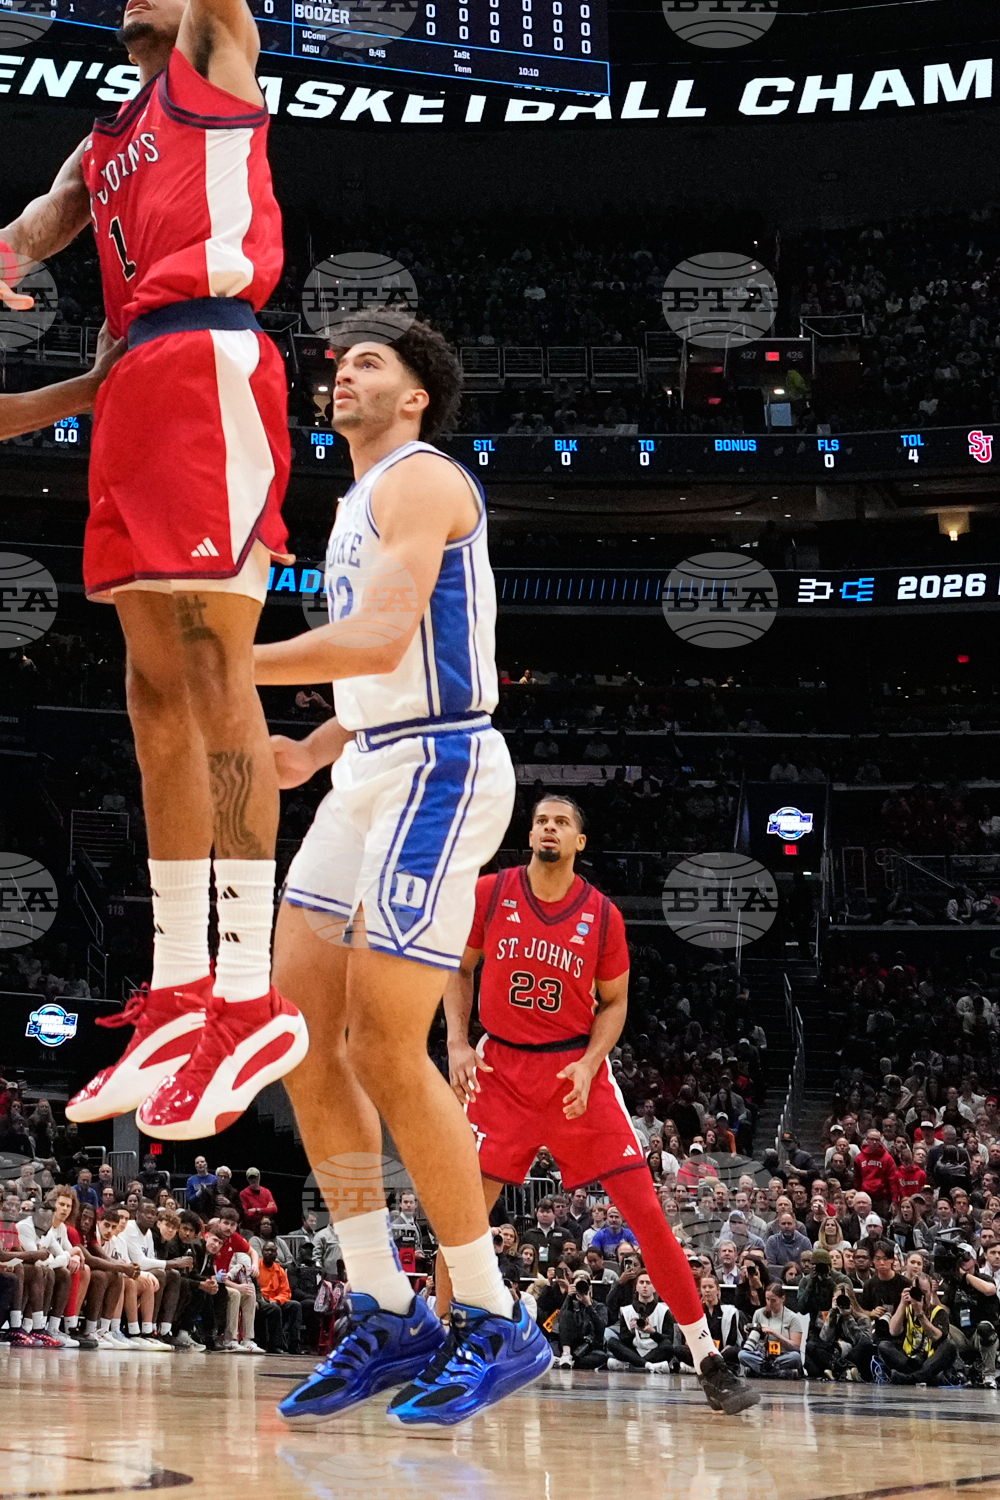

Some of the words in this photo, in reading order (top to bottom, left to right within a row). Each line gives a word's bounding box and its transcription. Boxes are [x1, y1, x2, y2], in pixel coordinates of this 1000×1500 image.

[295, 4, 349, 24] BOOZER
[303, 30, 326, 41] UConn
[302, 45, 319, 53] MSU
[454, 64, 471, 73] Tenn
[519, 67, 539, 77] 10:10
[738, 58, 993, 116] CHAM
[108, 216, 136, 282] 1
[55, 428, 77, 443] 0.0
[310, 433, 334, 445] REB
[901, 434, 924, 447] TOL
[473, 440, 495, 451] STL
[554, 440, 577, 452] BLK
[638, 440, 655, 451] TO
[714, 439, 757, 451] BONUS
[817, 439, 839, 451] FLS
[316, 446, 326, 459] 0
[478, 452, 488, 466] 0
[561, 452, 571, 466] 0
[639, 452, 650, 466] 0
[908, 449, 919, 463] 4
[824, 453, 834, 468] 0
[897, 572, 987, 600] 2026
[496, 937, 519, 960] ST.
[524, 937, 584, 979] JOHN'S
[509, 970, 563, 1013] 23
